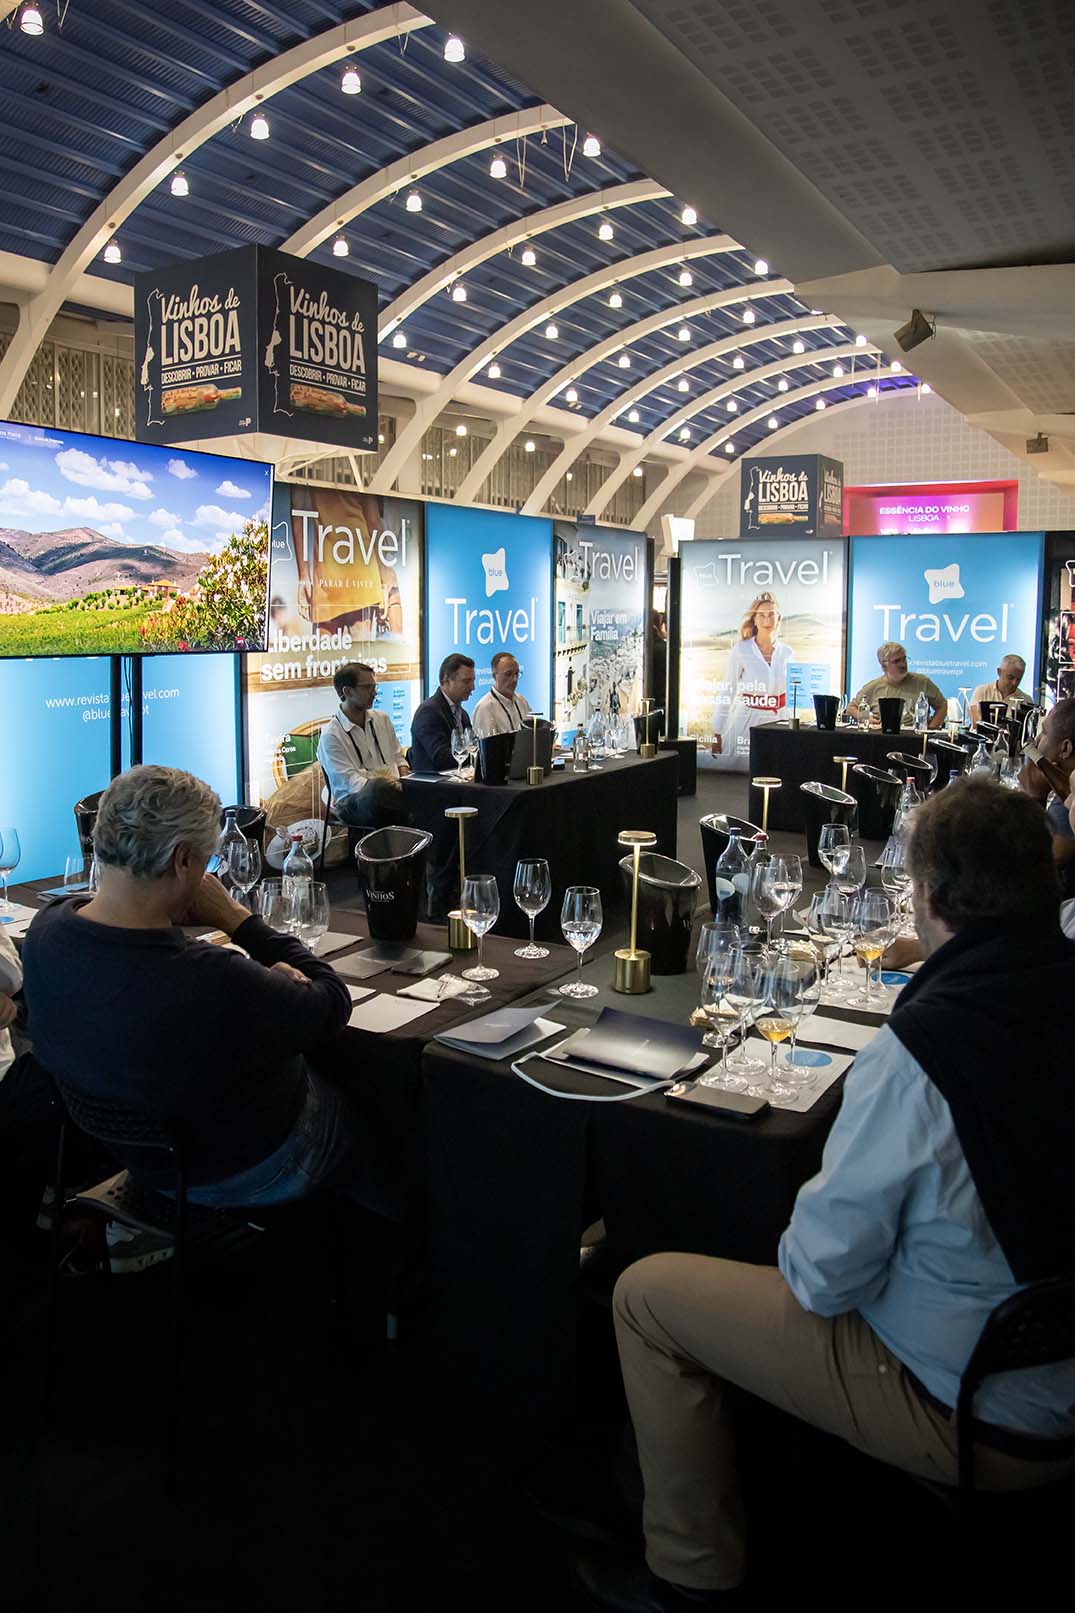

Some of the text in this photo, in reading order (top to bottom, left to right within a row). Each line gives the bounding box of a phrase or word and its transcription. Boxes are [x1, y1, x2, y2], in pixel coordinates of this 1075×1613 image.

[161, 284, 240, 323] Vinhos de
[289, 285, 365, 333] Vinhos de
[161, 310, 241, 365] LISBOA
[289, 315, 366, 375] LISBOA
[161, 360, 242, 385] DESCOBRIR PROVAR FICAR
[289, 363, 367, 392] DESCOBRIR PROVAR FICAR
[759, 466, 797, 483] Vinhos
[758, 481, 809, 502] LISBOA
[880, 504, 970, 515] ESSÊNCIA DO VINHO
[908, 513, 940, 522] LISBOA
[272, 539, 286, 549] lue
[291, 509, 407, 568] Travel
[487, 566, 503, 577] blue
[578, 541, 641, 582] Travel
[718, 551, 829, 586] Travel
[933, 579, 956, 588] blue
[444, 597, 537, 646] Travel
[592, 609, 616, 629] Viajar
[872, 603, 1010, 643] Travel
[591, 624, 619, 641] Família
[261, 654, 388, 682] sem fronas
[737, 679, 768, 694] pela
